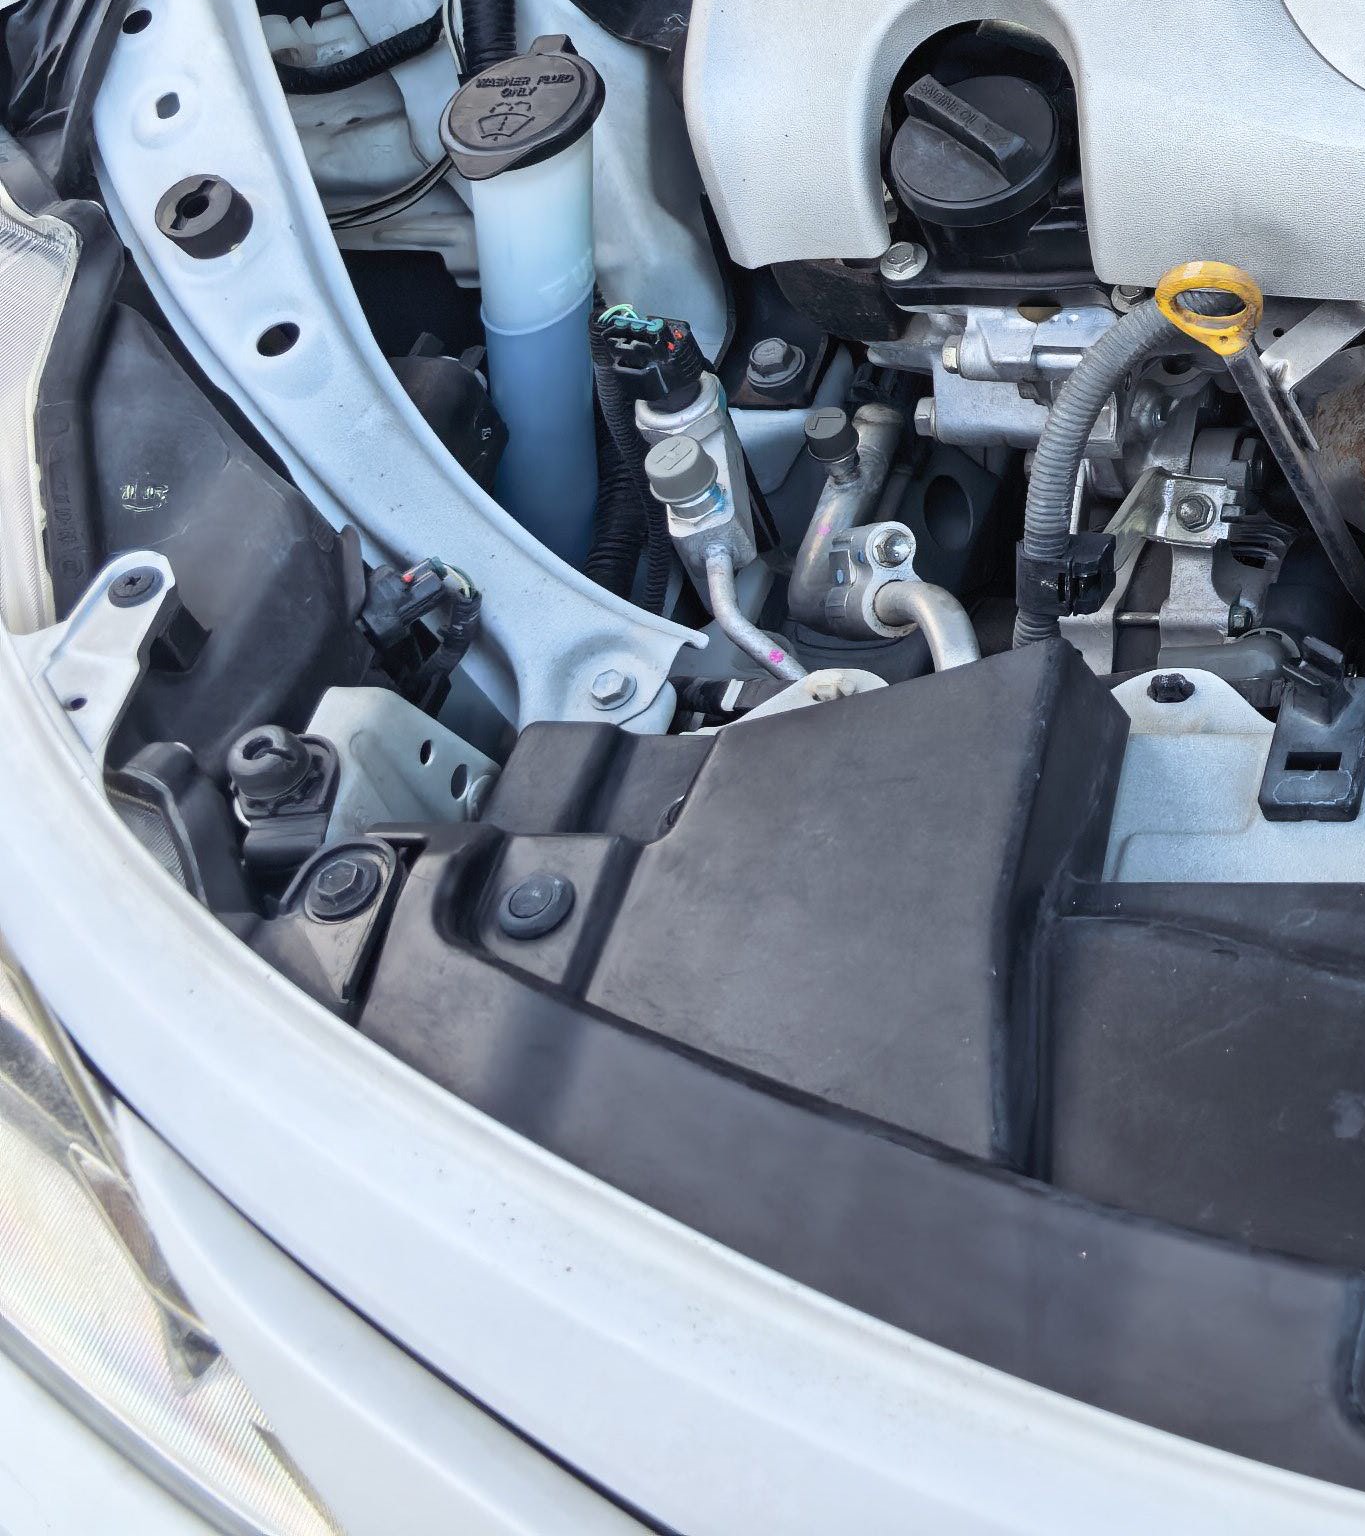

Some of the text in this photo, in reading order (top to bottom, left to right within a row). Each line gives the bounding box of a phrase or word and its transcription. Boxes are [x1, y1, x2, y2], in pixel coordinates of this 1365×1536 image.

[476, 73, 574, 89] WASHER FLUID
[501, 86, 538, 98] ONLY
[958, 108, 979, 126] OIL
